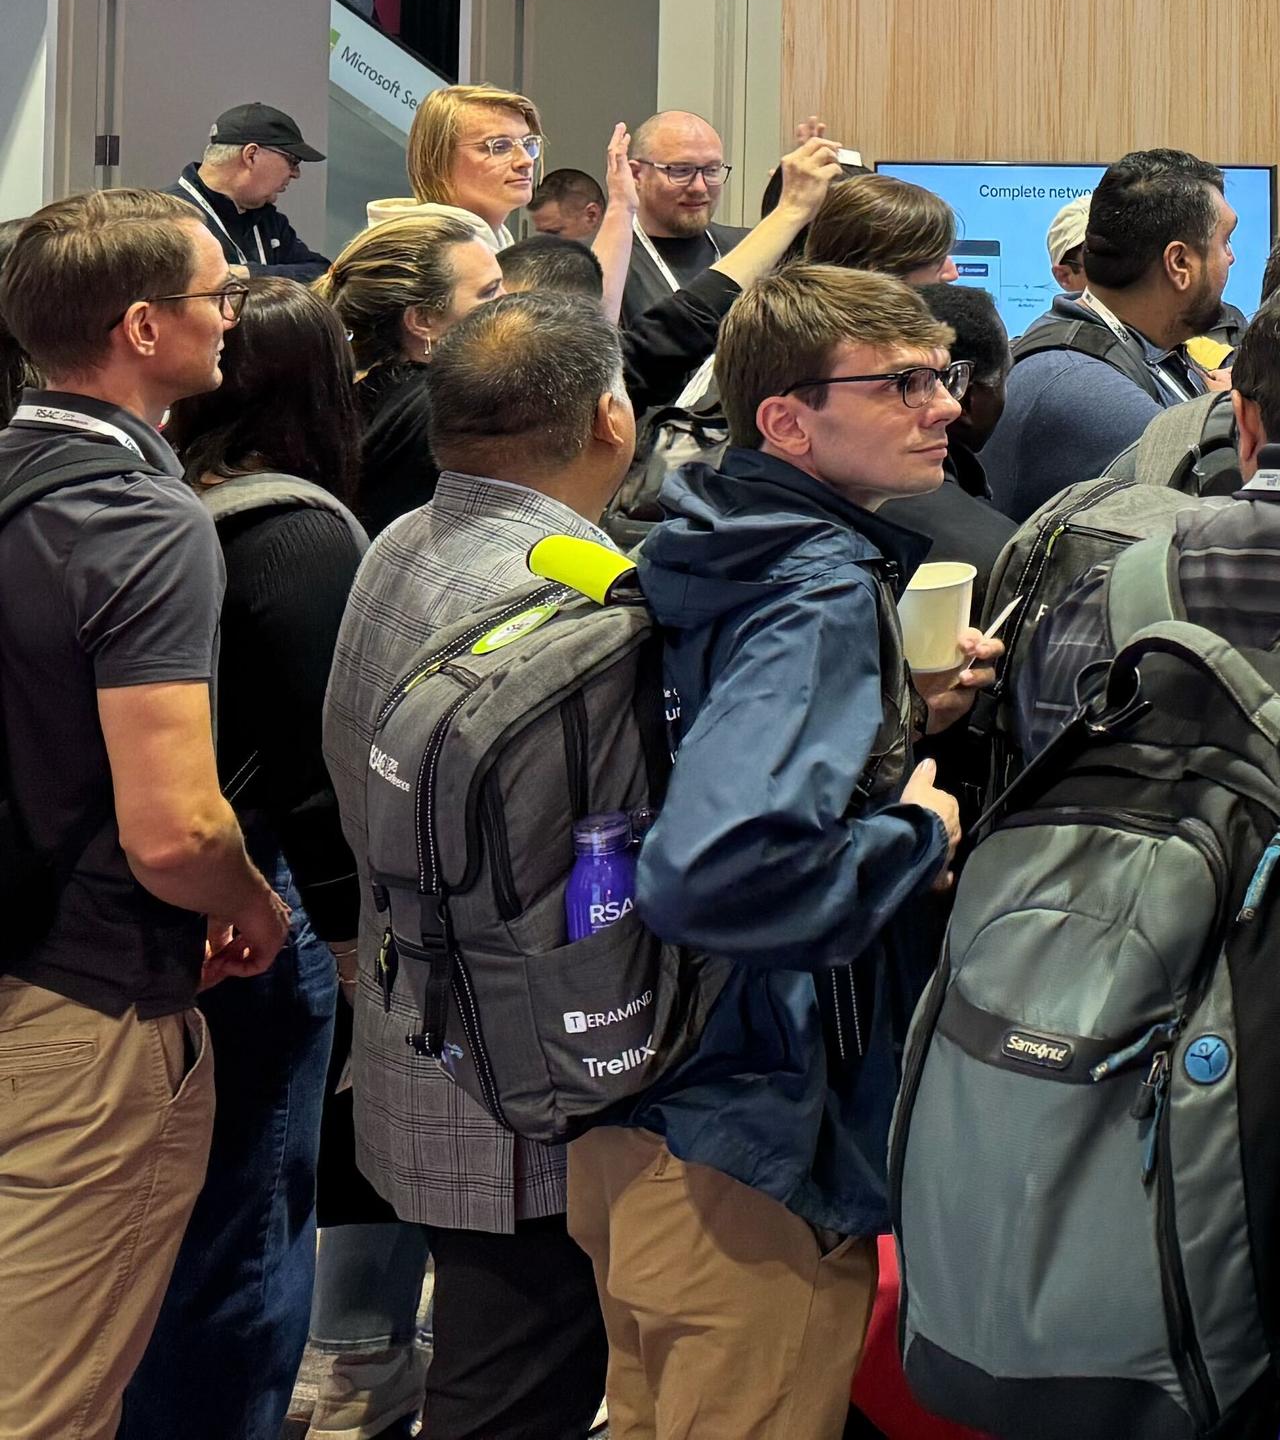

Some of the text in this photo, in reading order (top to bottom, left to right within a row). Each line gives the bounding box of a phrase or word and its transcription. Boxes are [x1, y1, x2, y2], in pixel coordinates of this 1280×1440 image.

[341, 46, 401, 98] Microsoft
[979, 184, 1092, 201] Complete netwo
[564, 990, 653, 1034] TERAMIND
[582, 1034, 656, 1078] Trellix
